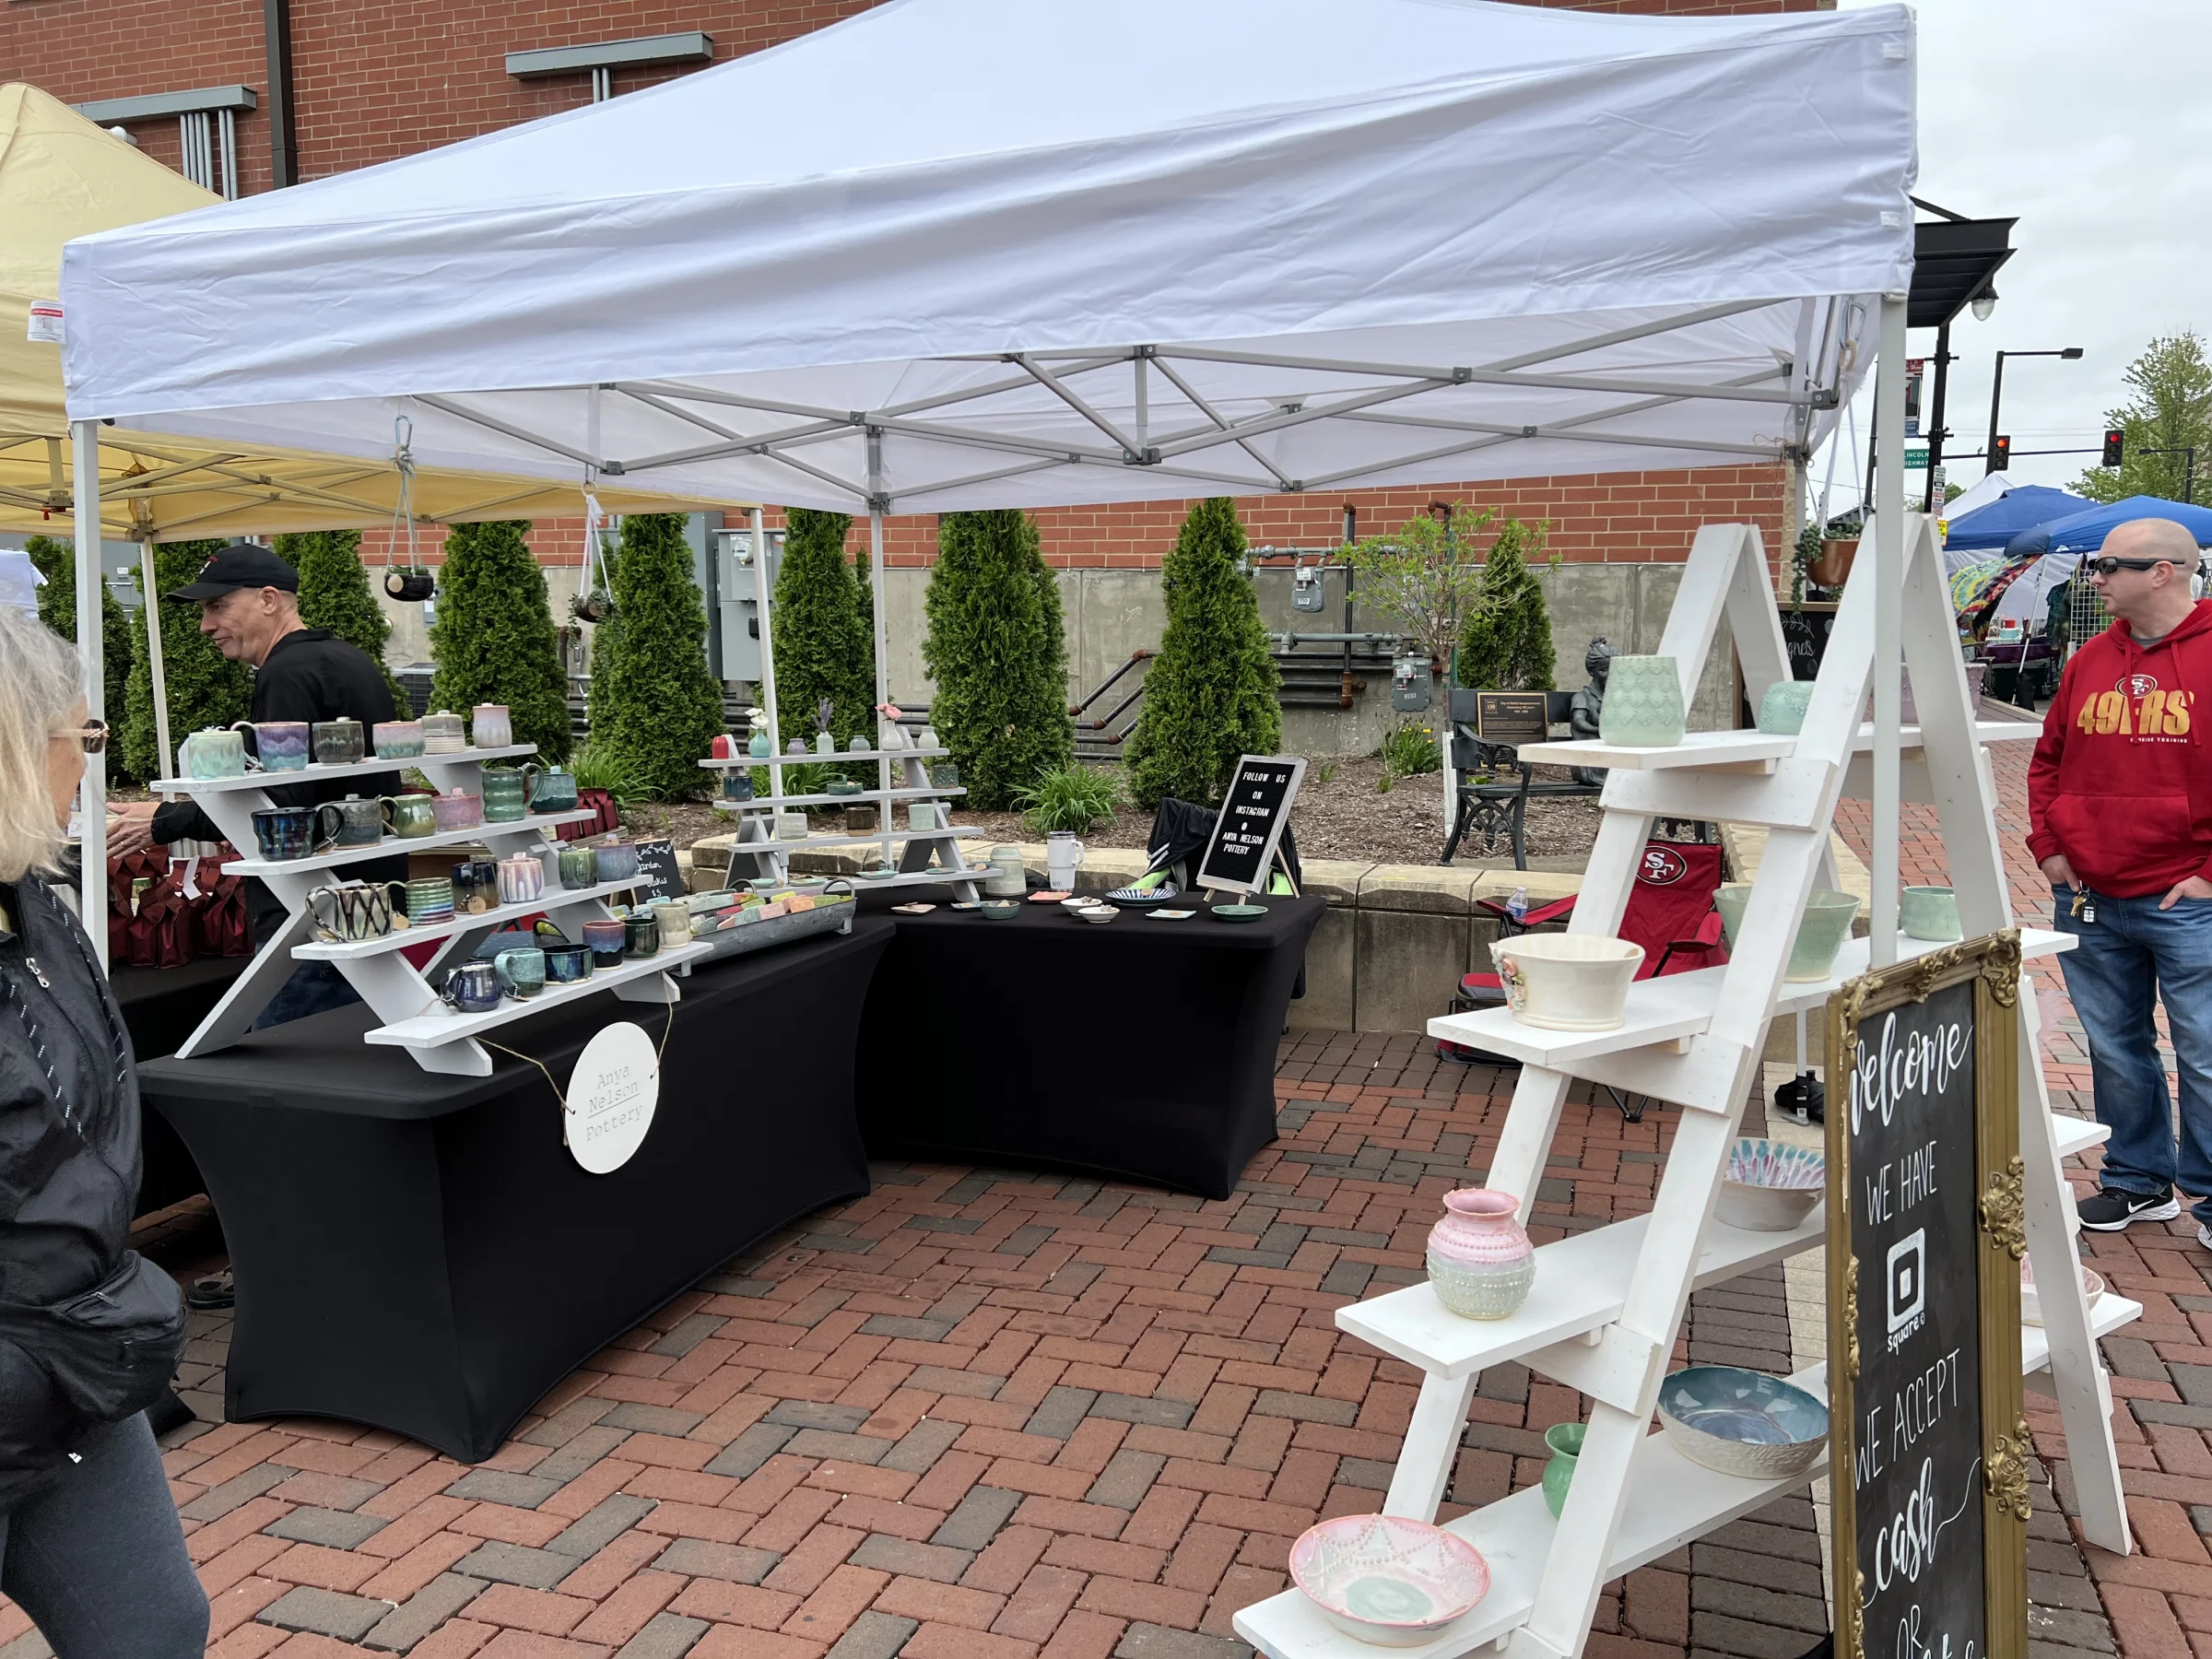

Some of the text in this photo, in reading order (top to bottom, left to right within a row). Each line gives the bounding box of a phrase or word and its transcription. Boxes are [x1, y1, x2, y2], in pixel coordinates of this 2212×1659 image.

[1788, 640, 1816, 661] gnets
[1242, 771, 1287, 783] FOLLOW US
[1252, 791, 1263, 800] ON
[1236, 806, 1269, 817] INSTAGRAM
[1222, 831, 1264, 844] ANYA NELSON
[1223, 843, 1250, 854] POTTERY
[597, 1065, 631, 1090] Anya
[588, 1080, 639, 1113] Nelson
[586, 1104, 643, 1142] Pottery
[1866, 1140, 1937, 1226] WE HAVE
[1854, 1347, 1960, 1490] WE ACCEPT
